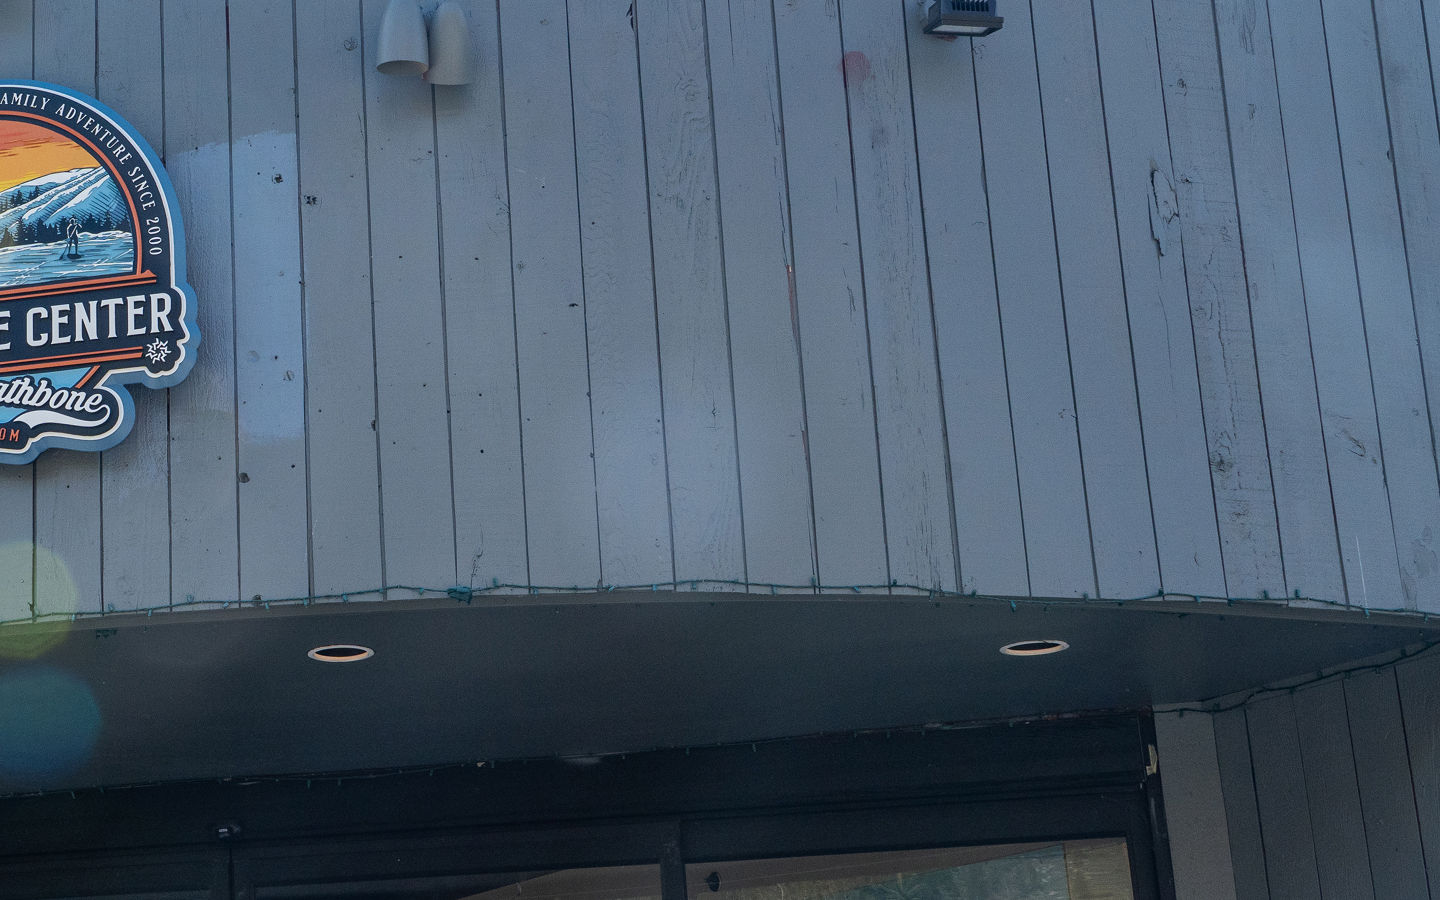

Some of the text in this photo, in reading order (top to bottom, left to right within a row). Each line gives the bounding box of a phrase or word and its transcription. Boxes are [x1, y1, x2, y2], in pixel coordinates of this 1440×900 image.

[55, 103, 133, 165] ADVENTURE
[127, 166, 156, 211] SINCE
[146, 216, 163, 255] 2000
[26, 291, 174, 347] CENTER
